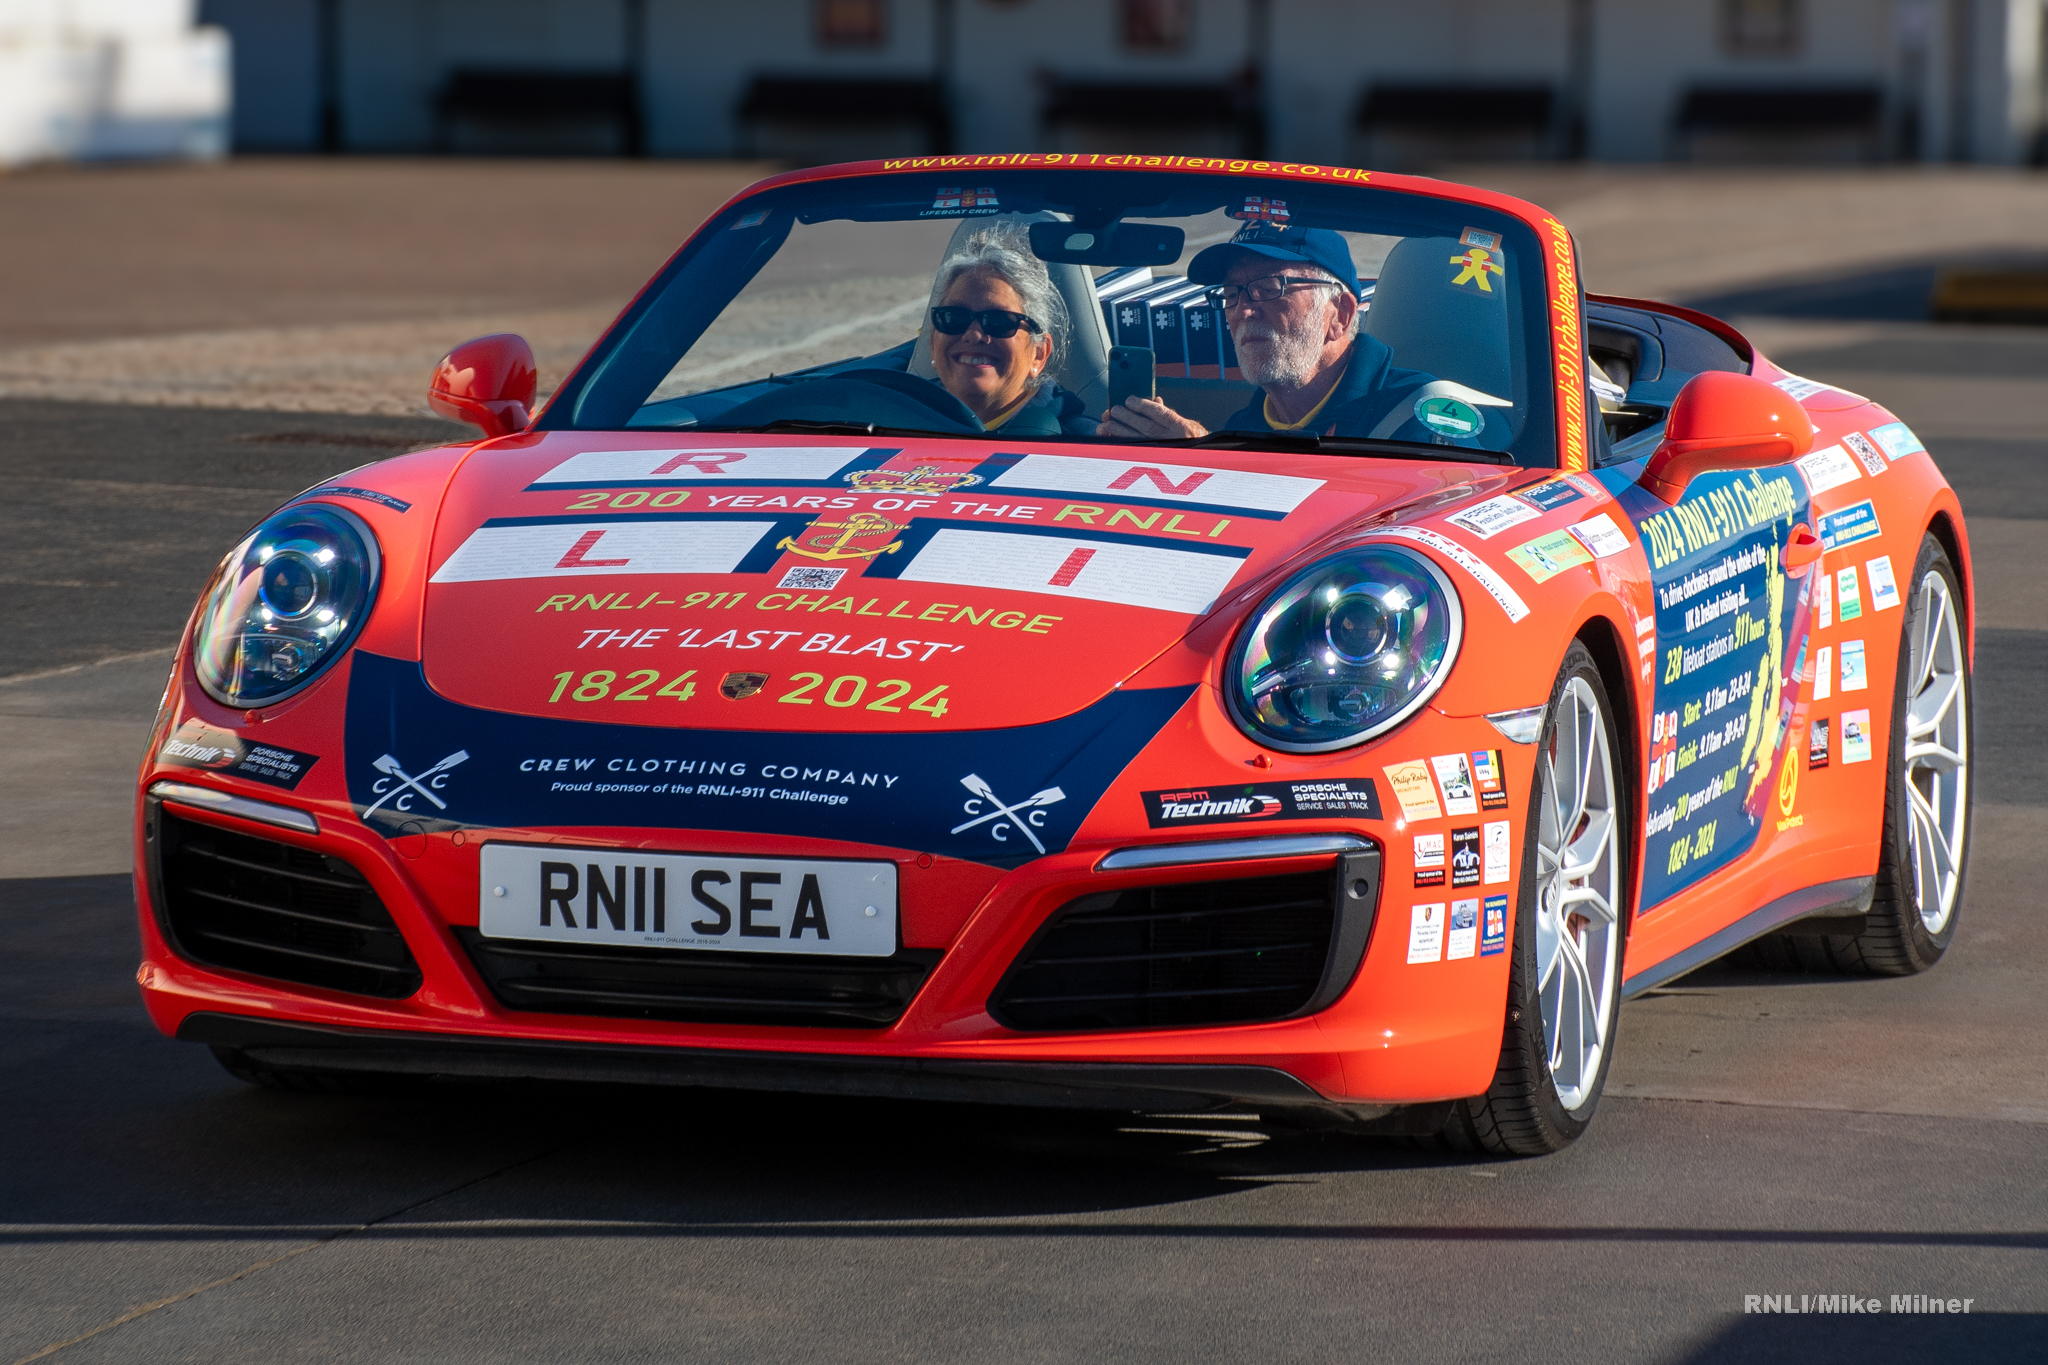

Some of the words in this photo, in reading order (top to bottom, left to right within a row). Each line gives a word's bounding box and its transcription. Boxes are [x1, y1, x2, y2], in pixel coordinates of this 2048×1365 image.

[883, 153, 1372, 182] www.rnli-911challenge.co.uk
[1442, 402, 1458, 417] 4
[650, 452, 747, 475] R
[1106, 466, 1215, 496] N
[565, 491, 691, 510] 200
[707, 495, 858, 508] YEARS
[872, 497, 927, 512] OF
[971, 501, 1043, 519] THE
[1053, 504, 1231, 538] RNLI
[1640, 511, 1685, 569] 2024
[1673, 485, 1744, 553] RNLI-911
[1734, 470, 1796, 527] Challenge
[554, 530, 630, 568] L
[1047, 547, 1097, 587] I
[1660, 588, 1668, 610] To
[1668, 579, 1682, 607] drive
[1682, 568, 1708, 602] clockwise
[1708, 560, 1728, 593] around
[1727, 556, 1736, 582] the
[1736, 549, 1752, 577] whole
[1752, 545, 1759, 570] of
[1756, 542, 1766, 567] the
[536, 592, 747, 612] RNLI-911
[756, 593, 1064, 634] CHALLENGE
[1686, 608, 1694, 632] UK
[1694, 605, 1700, 628] &
[1700, 593, 1720, 625] Ireland
[1719, 589, 1739, 616] visiting
[576, 628, 668, 649] THE
[1664, 644, 1683, 685] 238
[1682, 644, 1705, 675] lifeboat
[1704, 632, 1728, 663] stations
[1727, 629, 1734, 654] in
[1734, 611, 1750, 650] 911
[1750, 617, 1766, 642] hours
[548, 669, 698, 703] 1824
[777, 672, 950, 718] 2024
[1682, 698, 1702, 728] Start:
[1704, 686, 1727, 716] 9.11am
[163, 739, 221, 762] Technik
[245, 754, 301, 773] SPECIALISTS
[252, 746, 295, 762] PORSCHE
[1676, 739, 1698, 772] Finish:
[1698, 729, 1722, 760] 9.11am
[519, 758, 596, 772] CREW
[606, 758, 747, 776] CLOTHING
[761, 765, 899, 789] COMPANY
[1291, 783, 1348, 792] PORSCHE
[550, 782, 593, 793] Proud
[595, 782, 650, 795] sponsor
[653, 783, 668, 794] of
[670, 784, 693, 795] the
[697, 784, 765, 799] RNLI-911
[769, 788, 849, 805] Challenge
[1162, 798, 1254, 819] Technik
[1294, 792, 1368, 801] SPECIALISTS
[1296, 802, 1323, 810] SERVICE
[1326, 802, 1346, 810] SALES
[1350, 802, 1368, 810] TRACK
[1674, 793, 1689, 822] 200
[1686, 795, 1706, 821] years
[1710, 774, 1723, 804] the
[1722, 764, 1739, 795] RNLI
[1776, 814, 1804, 832] MaxProtect
[1668, 833, 1691, 876] 1824
[1694, 819, 1718, 861] 2024
[690, 869, 830, 940] SEA
